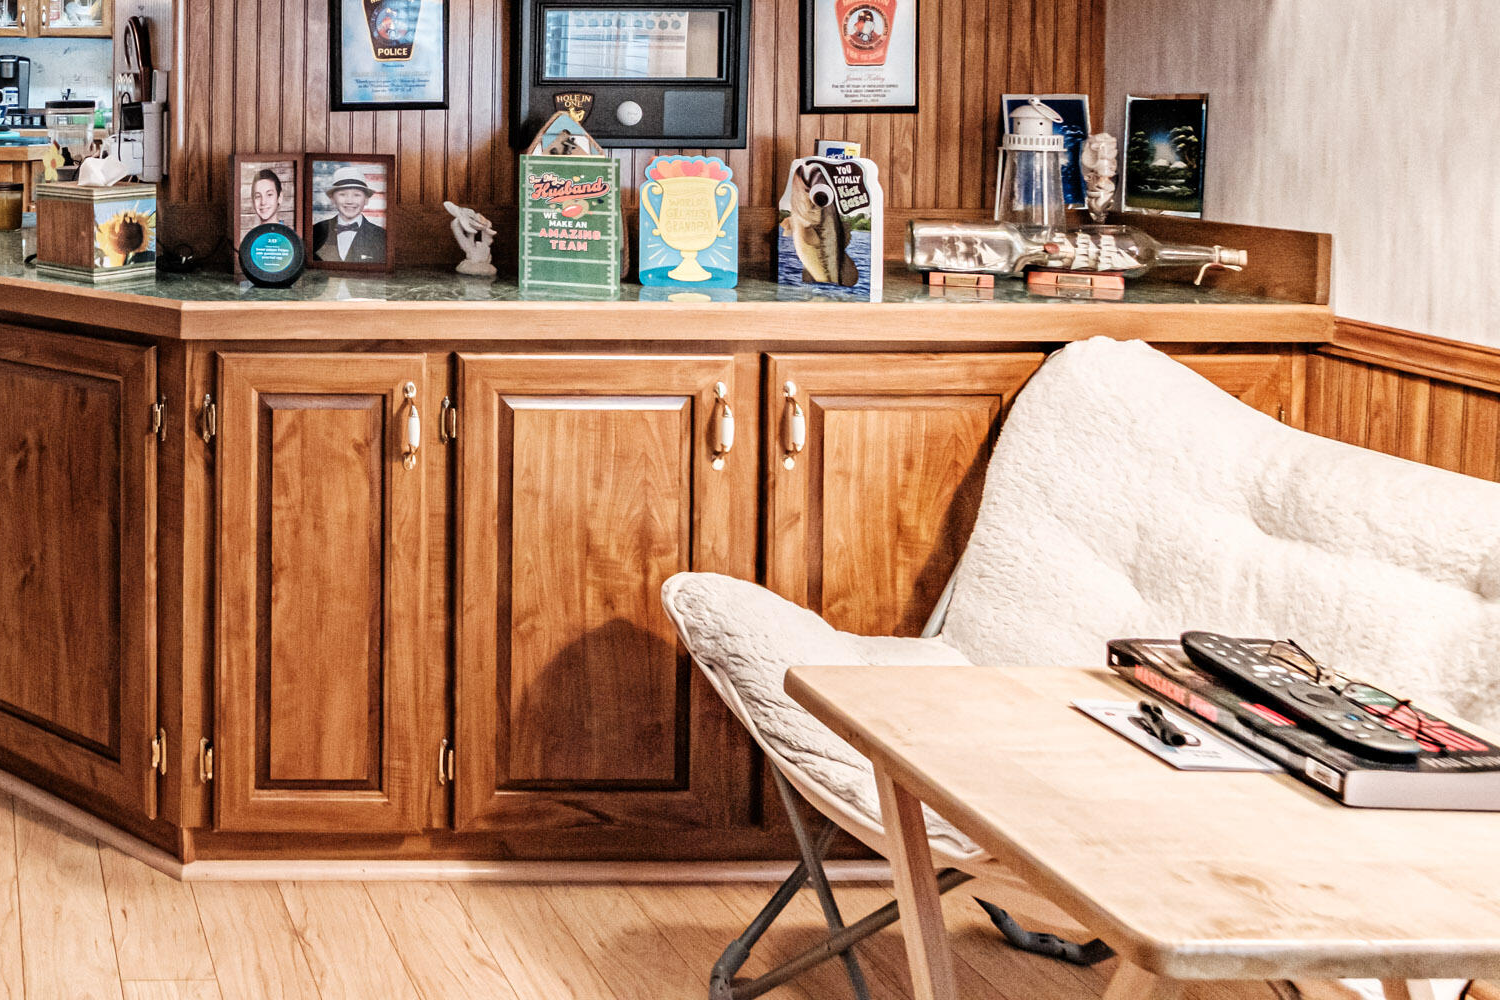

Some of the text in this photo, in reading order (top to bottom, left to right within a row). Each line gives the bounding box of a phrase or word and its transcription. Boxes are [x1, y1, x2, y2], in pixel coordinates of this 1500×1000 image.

[377, 47, 408, 57] POLICE
[556, 94, 580, 103] HOLE
[836, 165, 852, 175] YOU
[531, 176, 606, 200] Husband
[543, 211, 558, 219] WE
[548, 220, 588, 229] MAKE AN
[539, 228, 602, 240] AMAZING
[549, 240, 588, 252] TEAM
